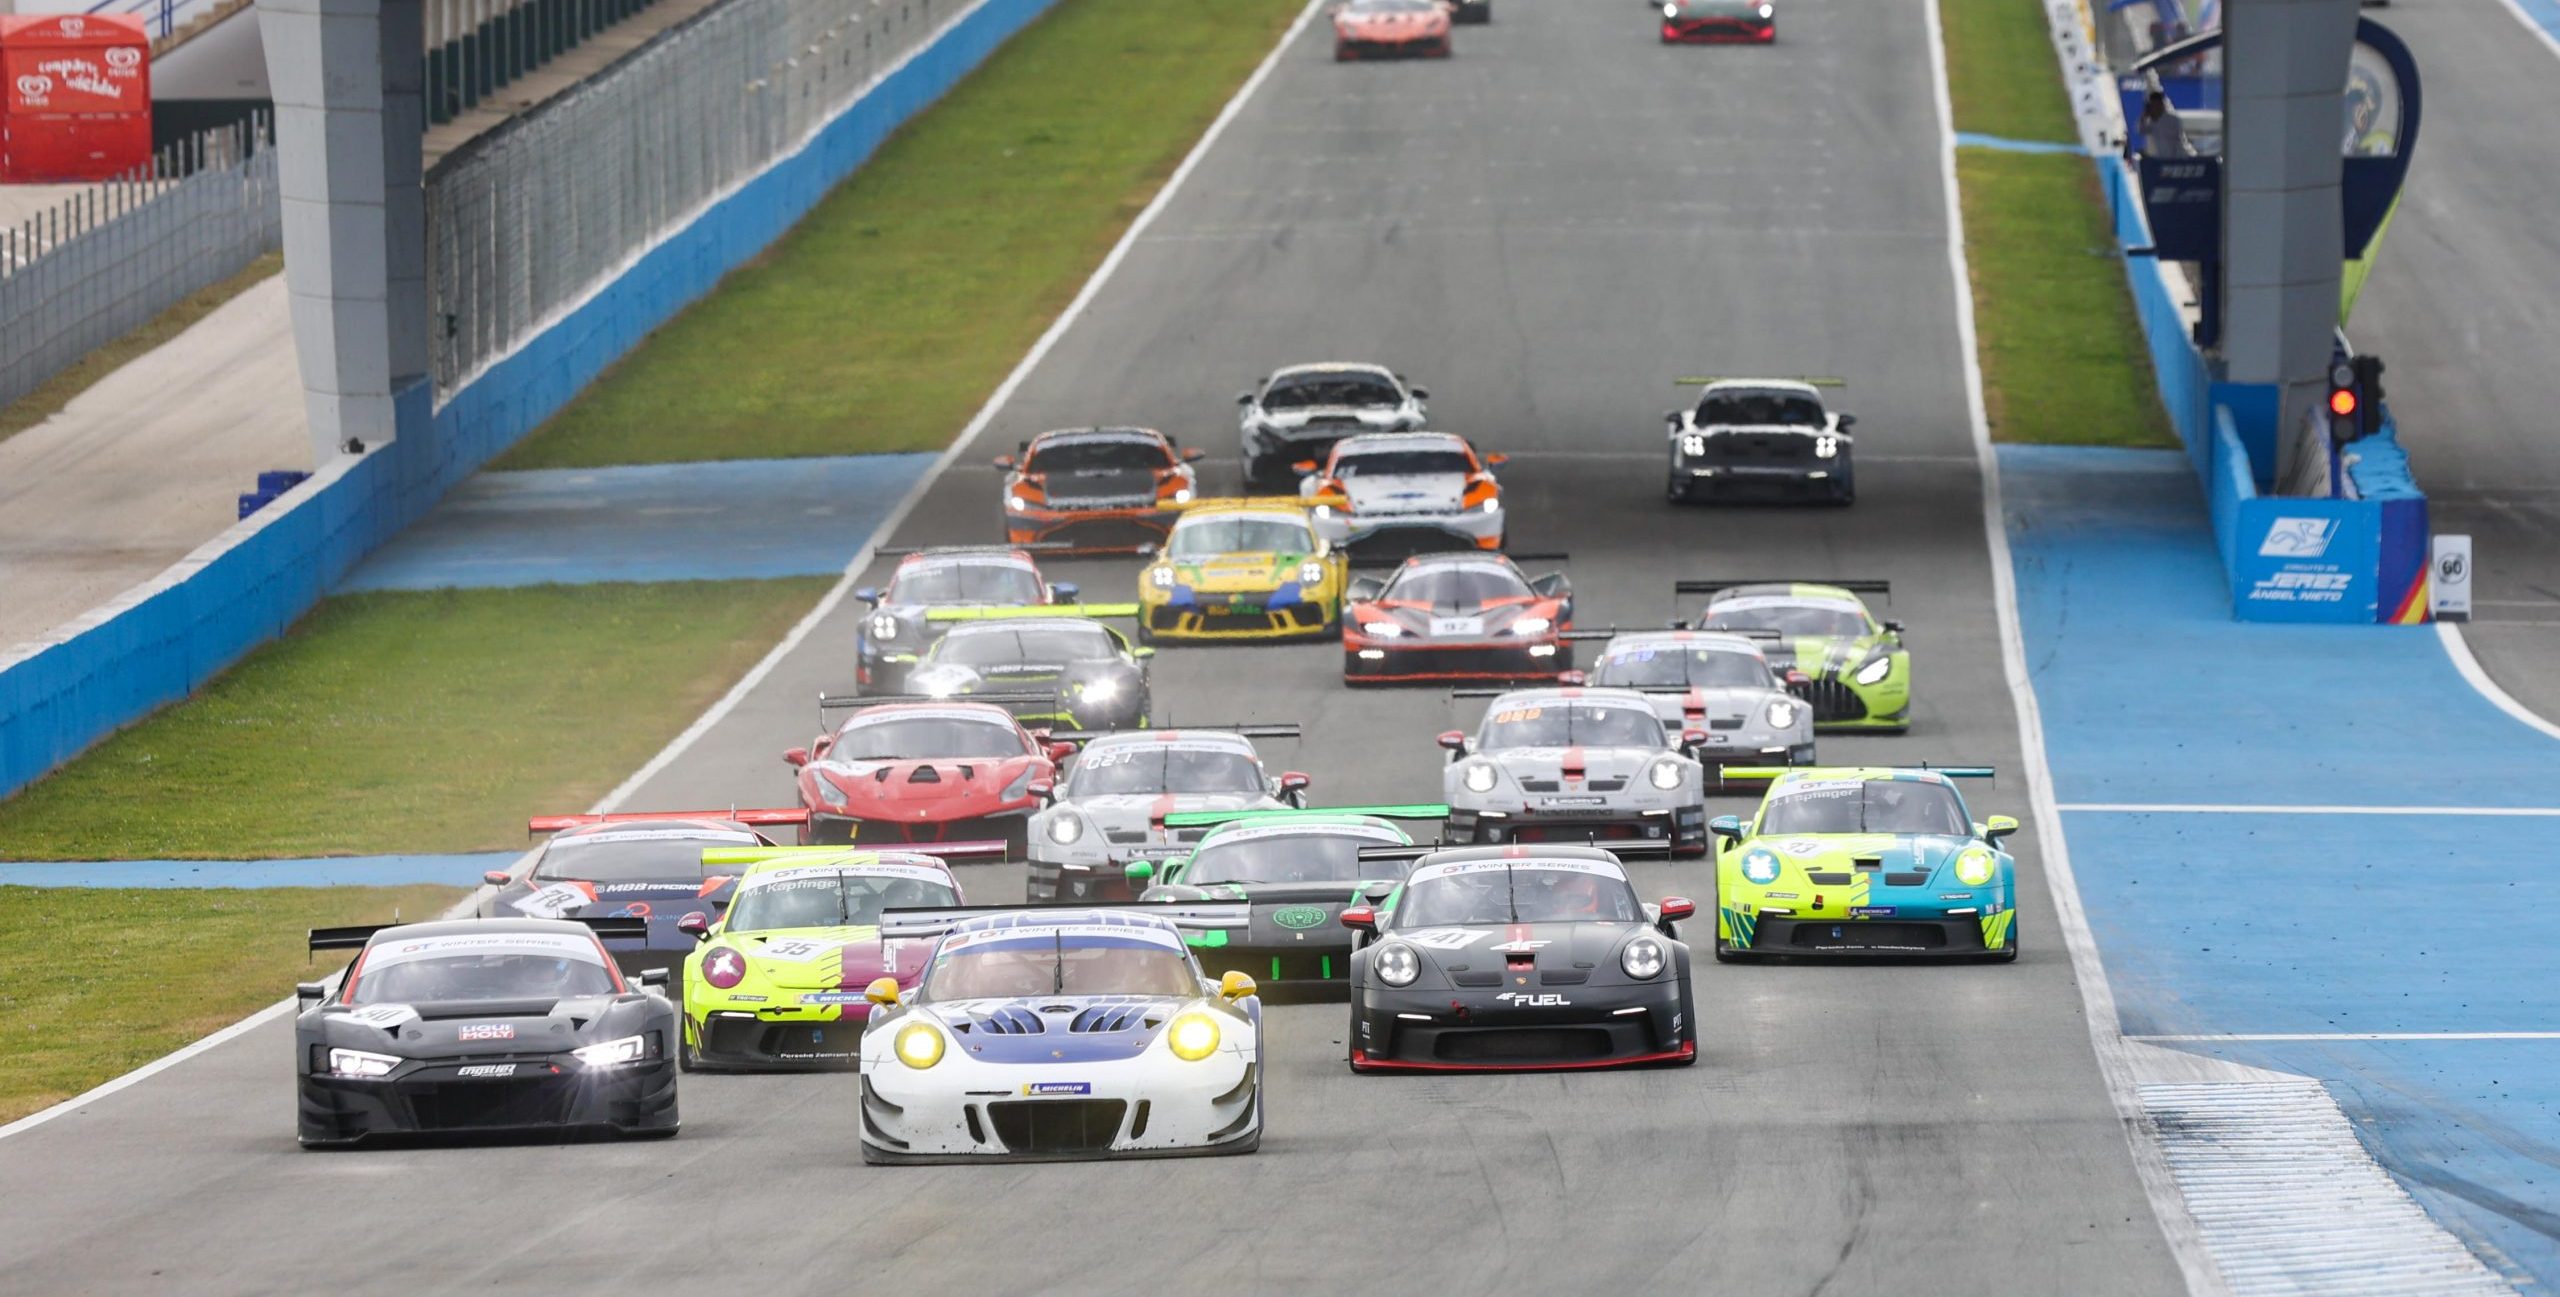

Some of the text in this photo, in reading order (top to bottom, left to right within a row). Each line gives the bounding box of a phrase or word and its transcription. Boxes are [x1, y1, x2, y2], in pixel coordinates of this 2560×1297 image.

[2442, 560, 2462, 575] 60
[2255, 572, 2352, 590] JEREZ
[2299, 591, 2343, 601] NIETO
[774, 868, 804, 878] GT
[866, 867, 918, 875] SERIES
[1442, 862, 1590, 874] GT WINTER SERIES
[607, 883, 647, 892] MBB
[978, 929, 1011, 938] GT
[1086, 926, 1145, 934] SERIES
[402, 942, 435, 952] GT
[441, 939, 499, 947] WINTER
[772, 942, 819, 956] 35
[1514, 994, 1571, 1007] FUEL
[462, 1024, 511, 1032] LIQUI
[462, 1031, 511, 1039] MOLY
